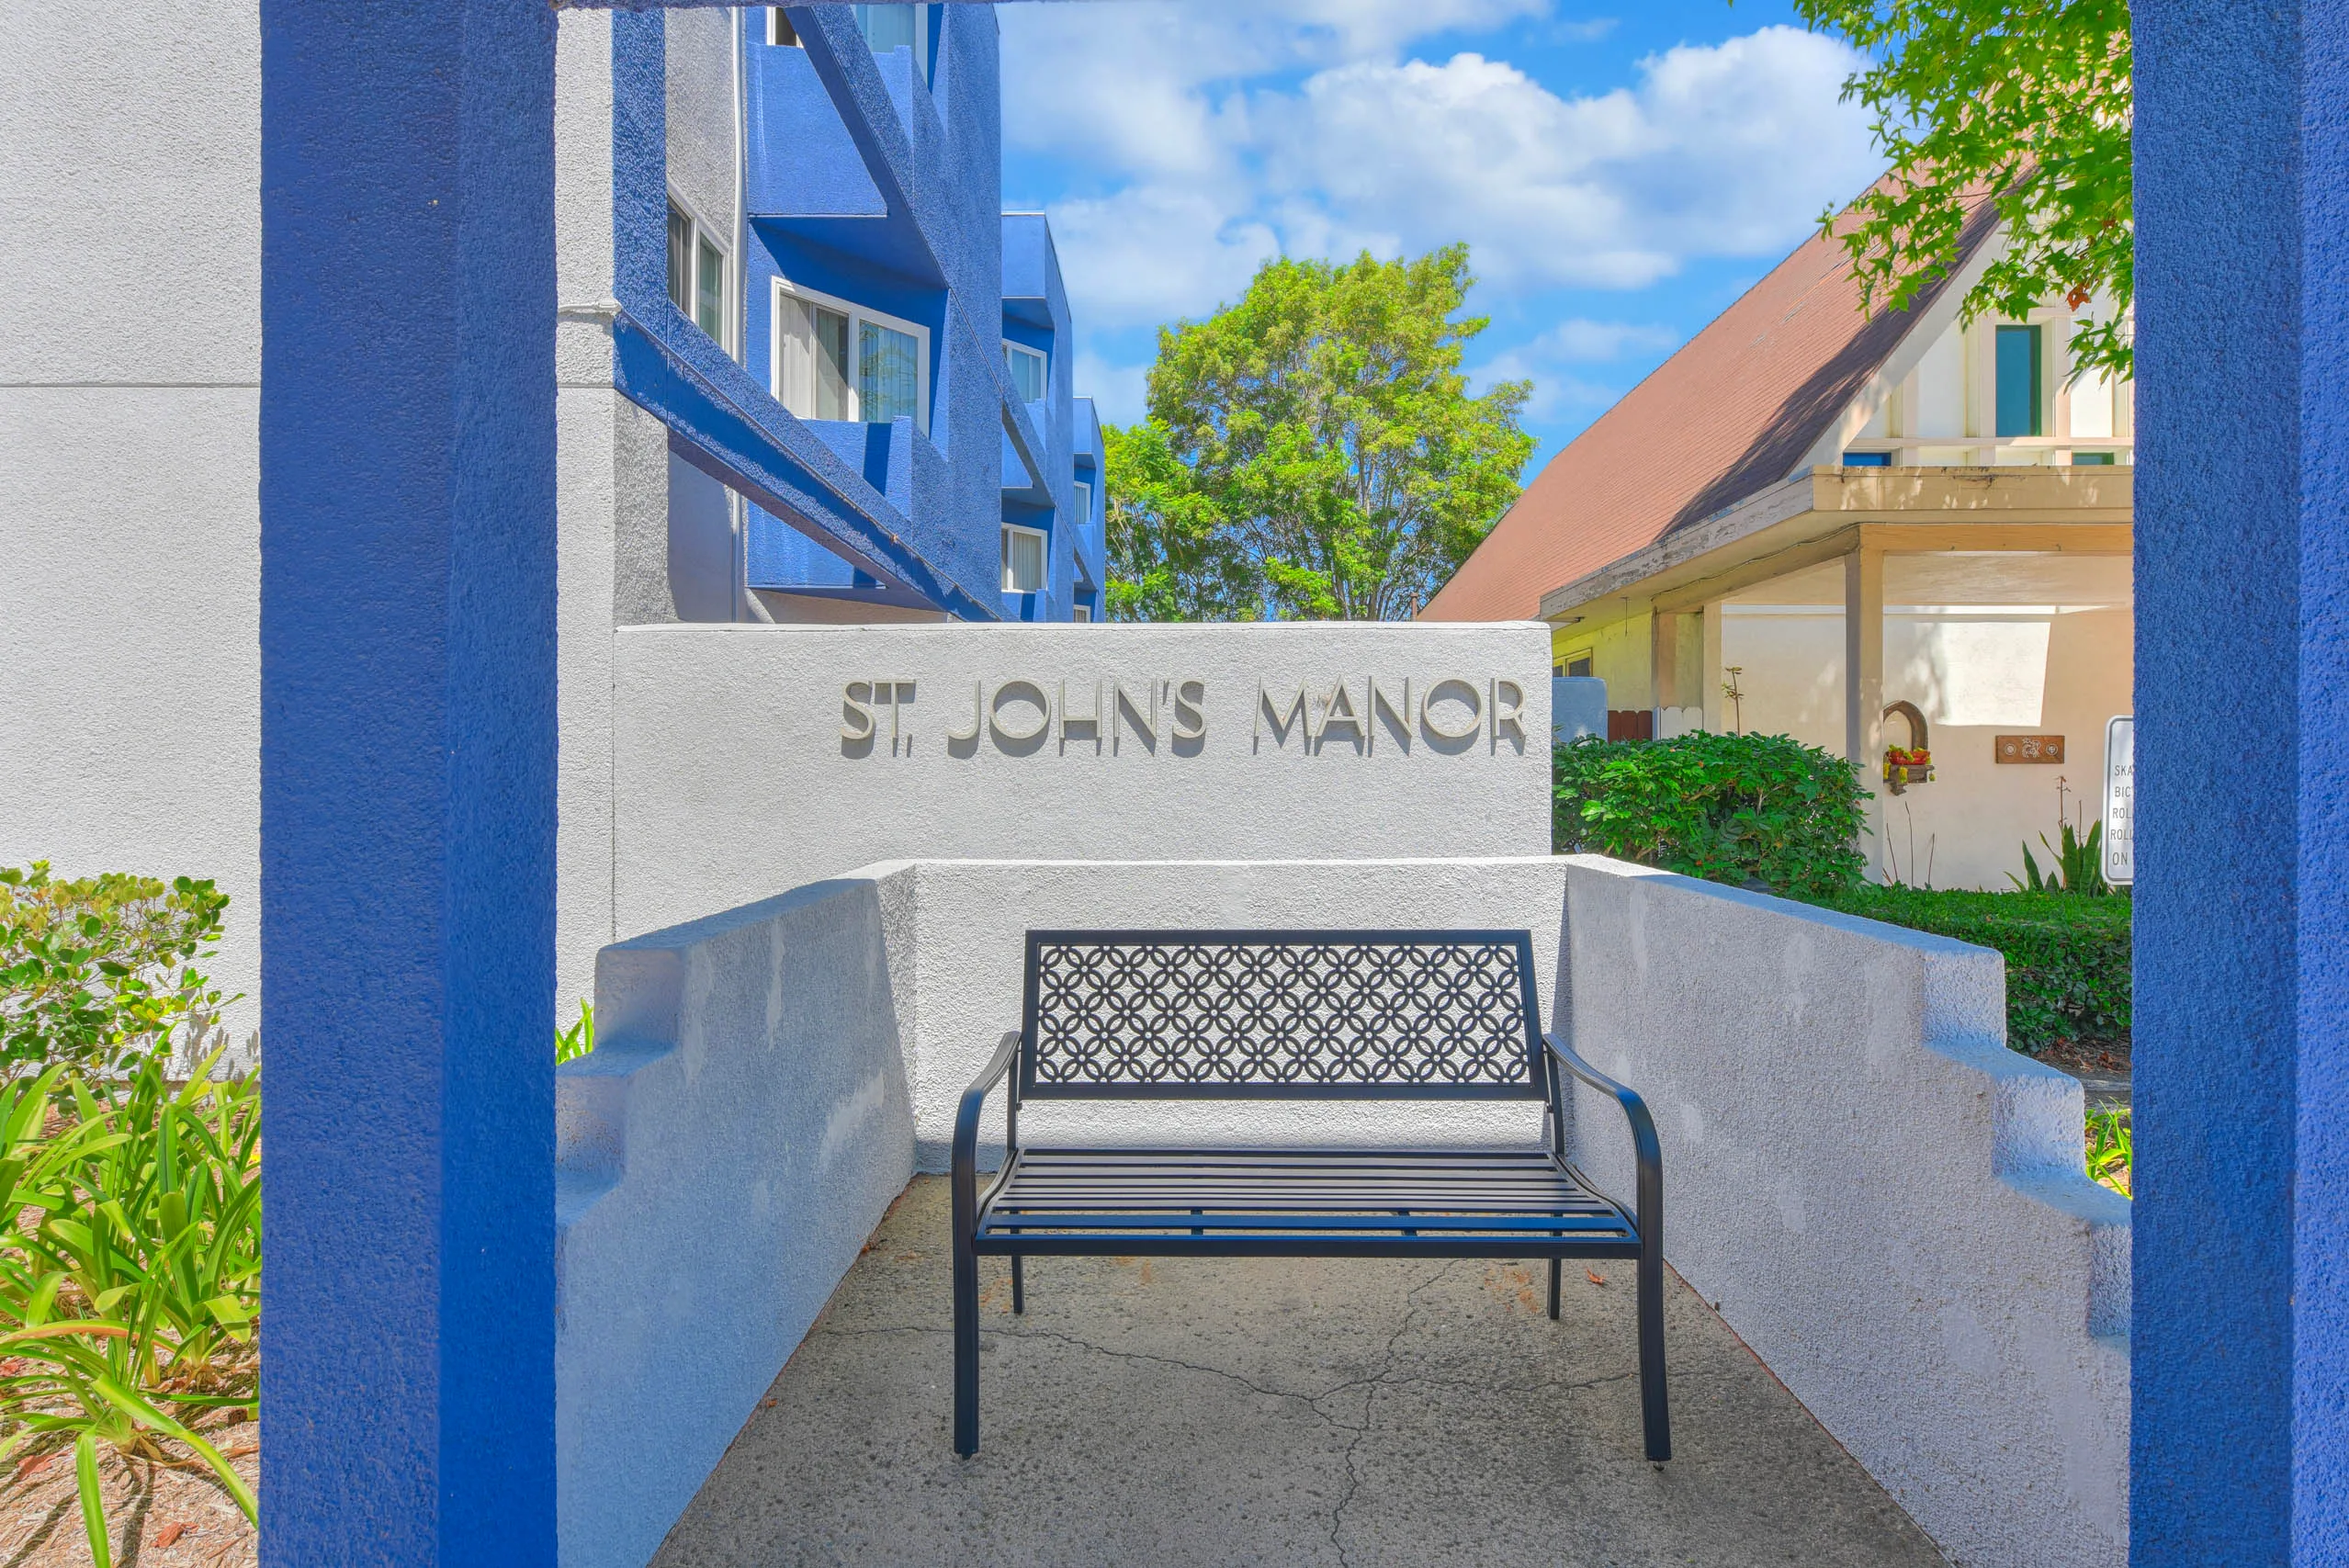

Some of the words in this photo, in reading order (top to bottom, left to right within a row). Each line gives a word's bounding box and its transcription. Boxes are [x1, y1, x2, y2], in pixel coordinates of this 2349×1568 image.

[947, 678, 1206, 740] JOHN'S
[1254, 675, 1527, 739] MANOR
[2115, 785, 2132, 797] BIC
[2112, 852, 2128, 865] ON
